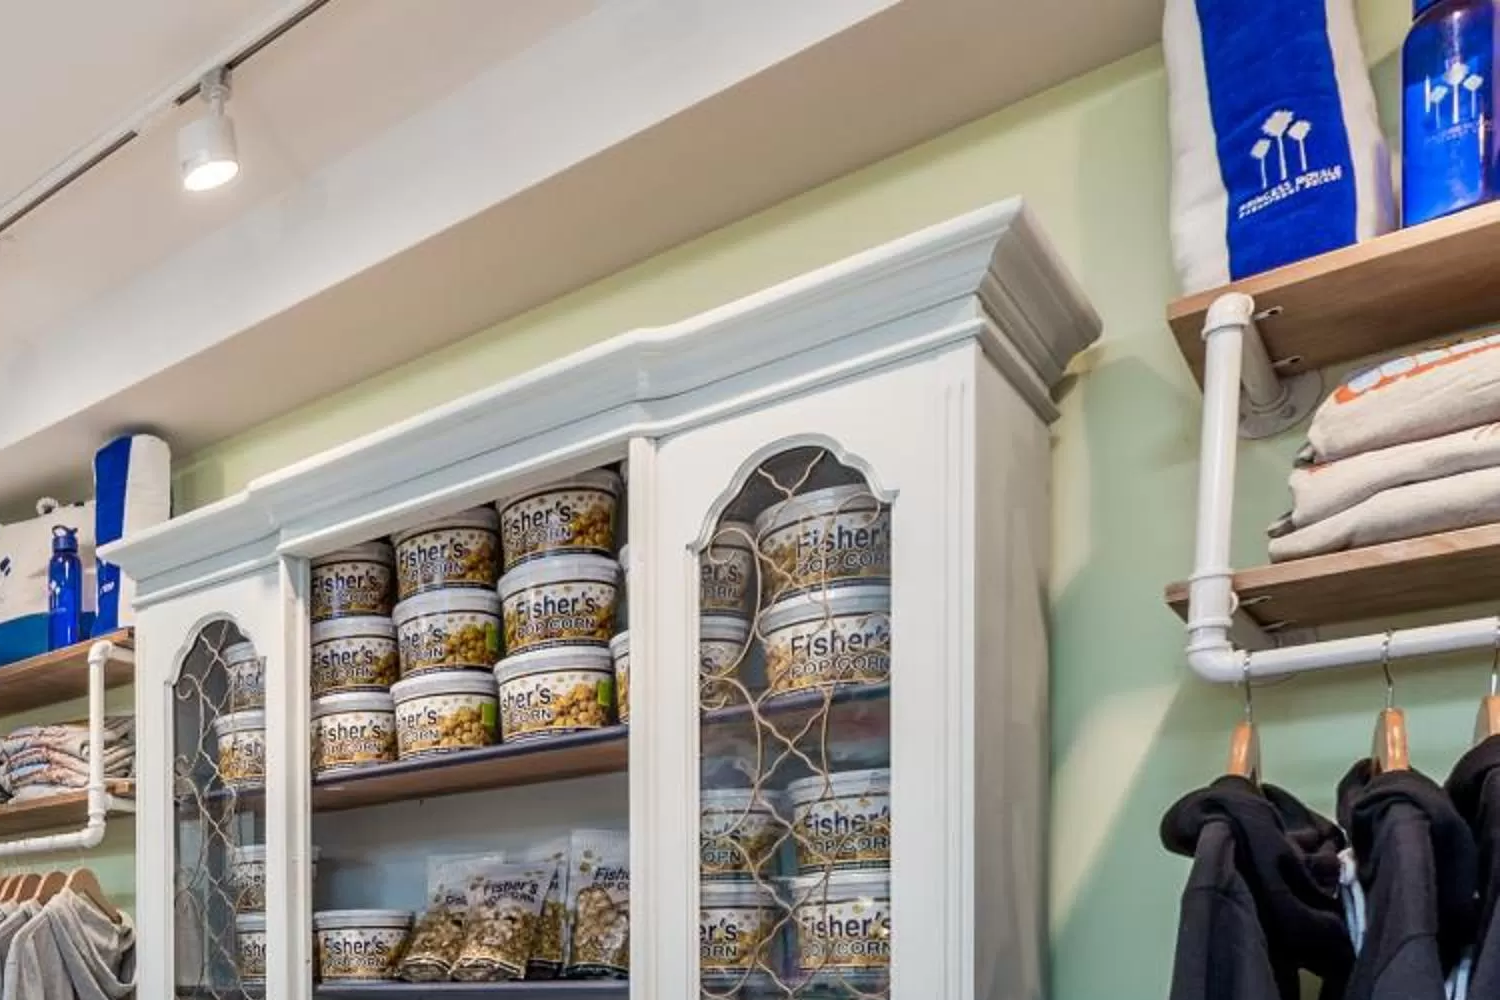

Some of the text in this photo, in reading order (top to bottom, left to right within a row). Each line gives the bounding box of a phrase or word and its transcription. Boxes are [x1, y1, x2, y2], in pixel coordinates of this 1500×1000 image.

[797, 521, 890, 558] Fisher'
[516, 591, 595, 621] Fisher's
[804, 805, 890, 837] Fisher'
